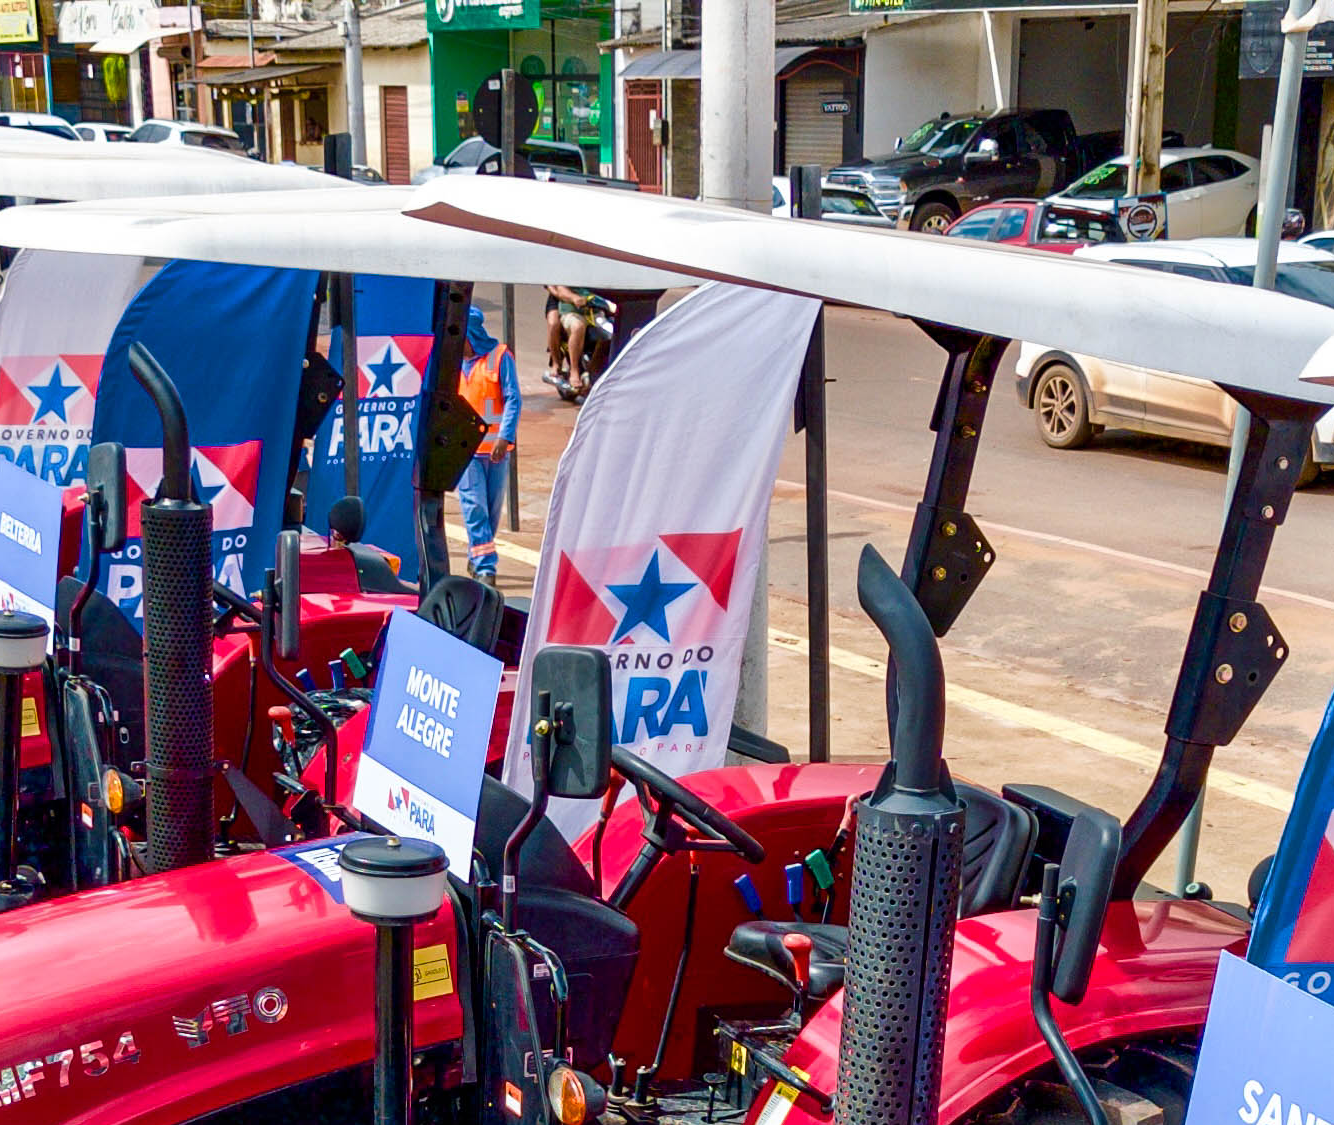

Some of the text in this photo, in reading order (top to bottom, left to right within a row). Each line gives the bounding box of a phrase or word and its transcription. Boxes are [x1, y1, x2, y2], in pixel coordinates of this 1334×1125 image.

[336, 401, 397, 415] GERNO
[0, 512, 43, 555] BELTERRA
[222, 534, 247, 551] DO
[682, 646, 714, 665] DO
[406, 665, 461, 719] MONTE
[396, 703, 454, 759] ALEGRE
[172, 986, 289, 1049] YTO
